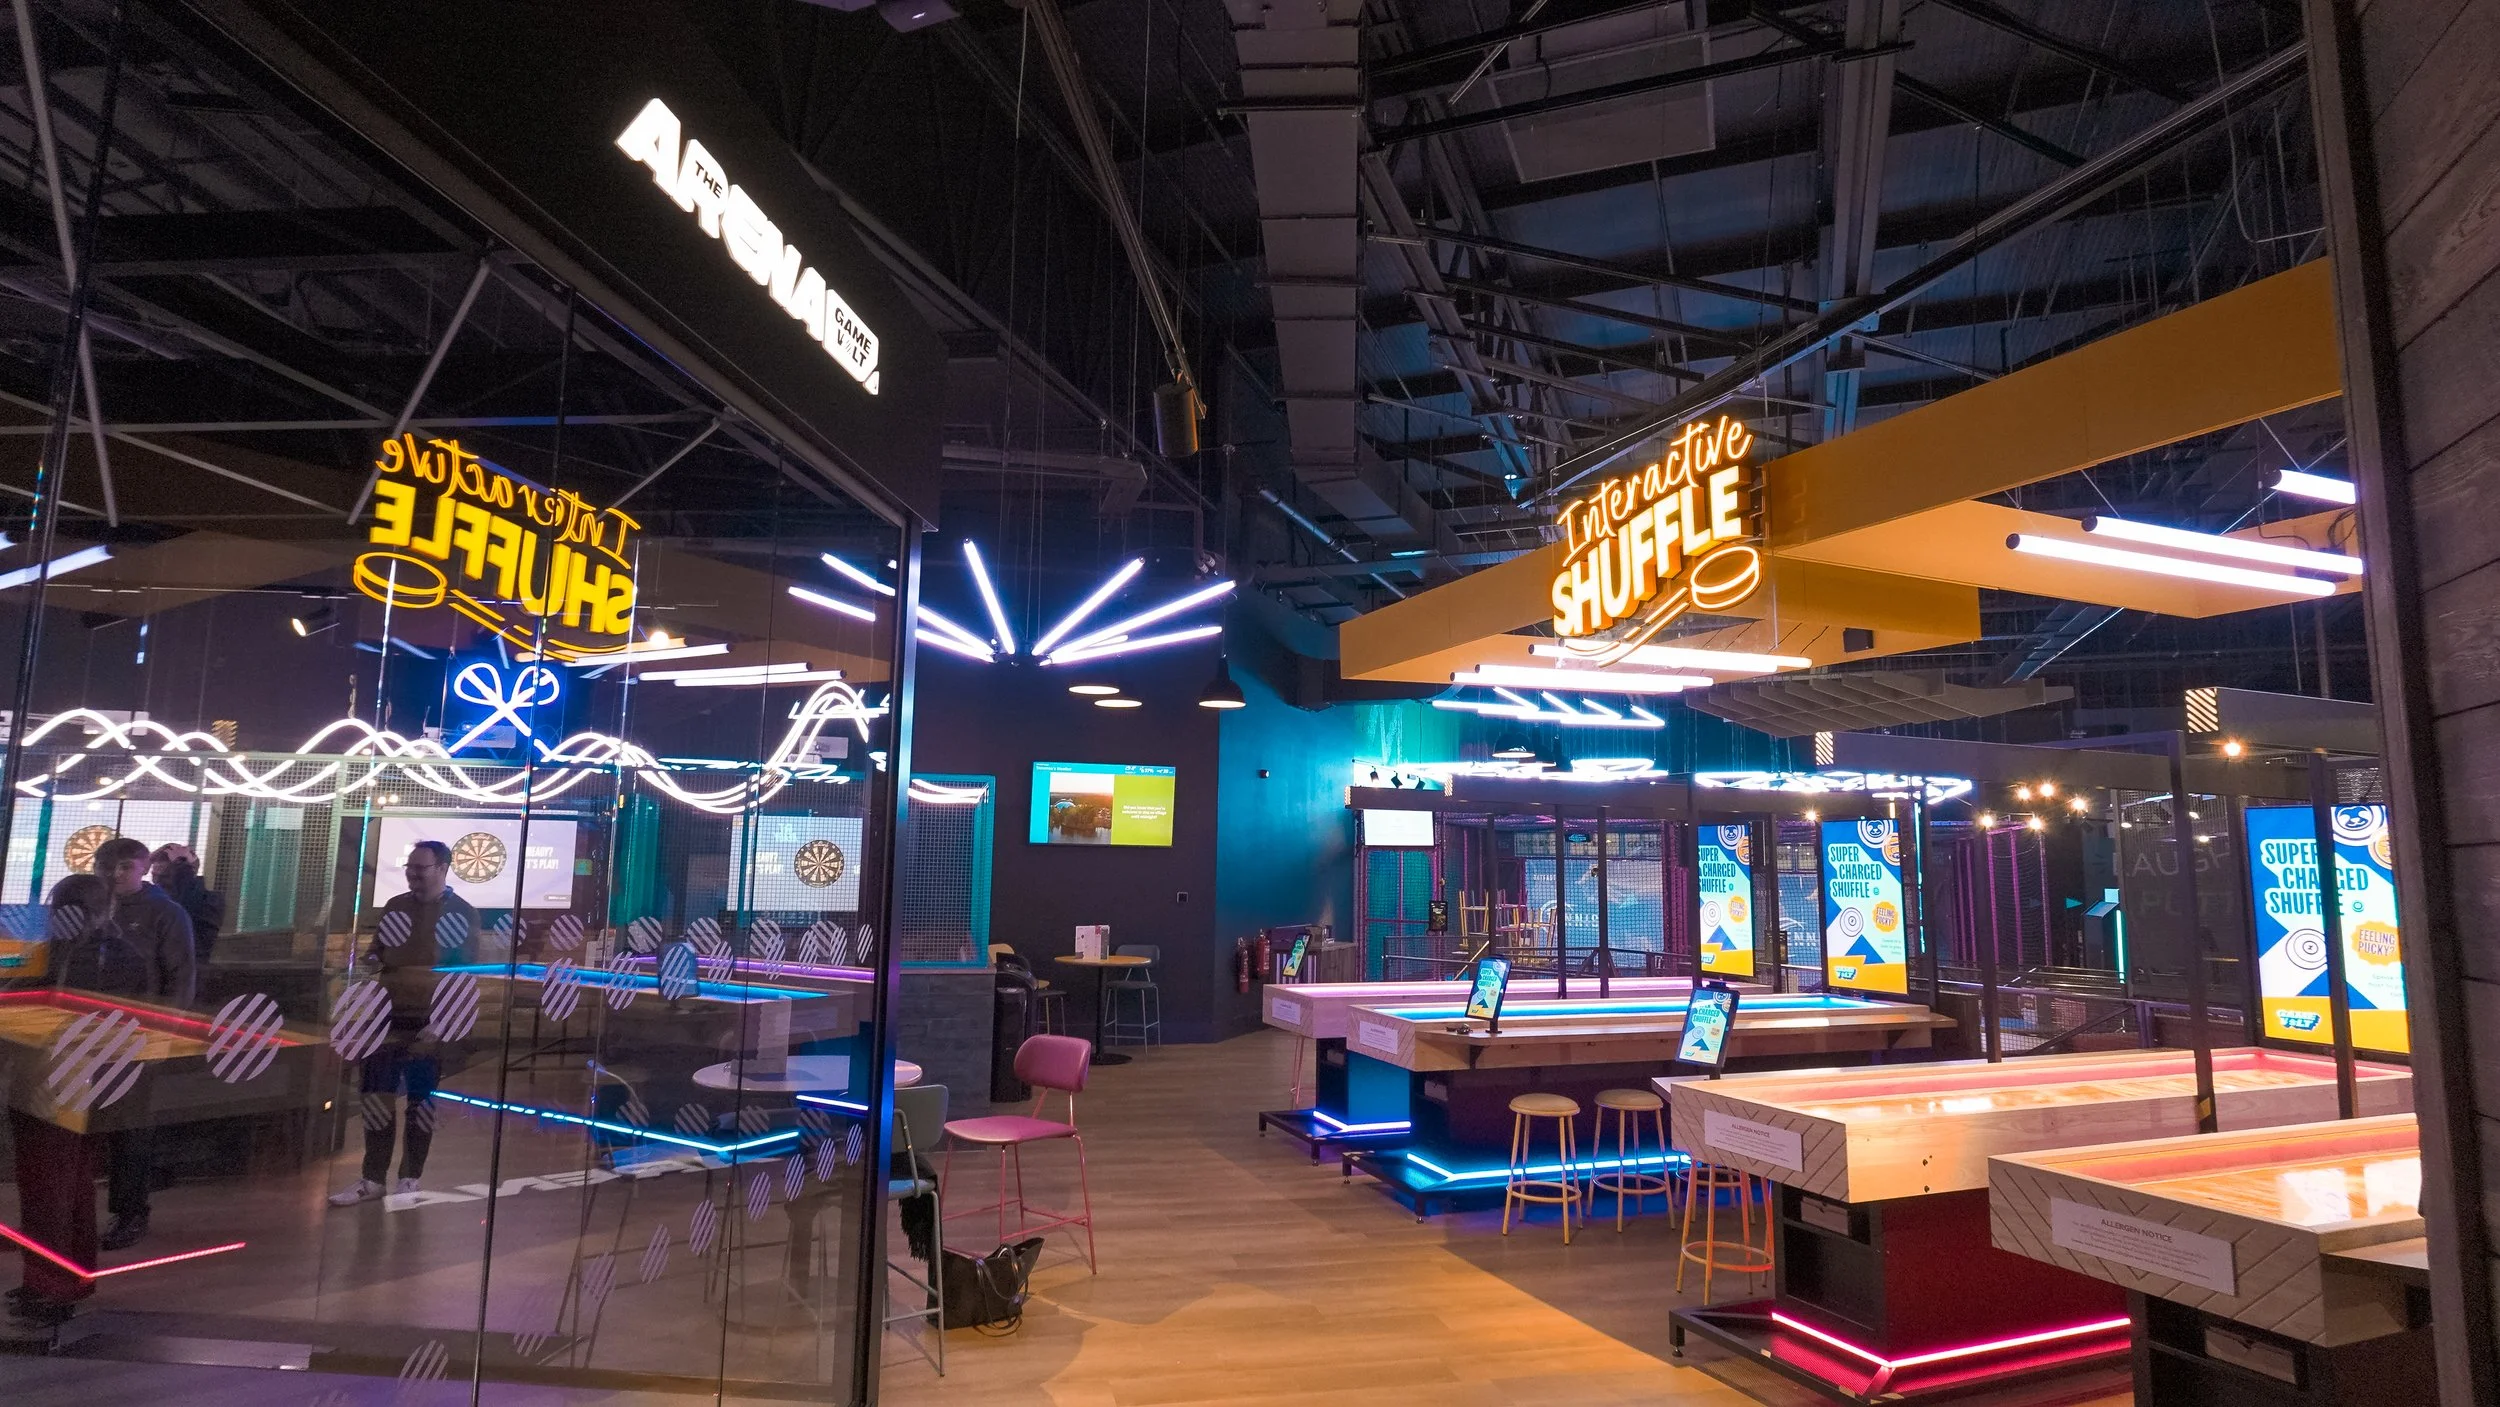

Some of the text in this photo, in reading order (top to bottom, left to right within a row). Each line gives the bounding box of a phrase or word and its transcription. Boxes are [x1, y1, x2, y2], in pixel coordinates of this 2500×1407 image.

[694, 160, 723, 199] THE
[835, 307, 872, 355] GAME
[1557, 415, 1754, 568] Interactive
[1552, 465, 1743, 637] SHUFFLE
[1699, 847, 1719, 861] UPER
[1830, 845, 1860, 862] SUPER
[1702, 863, 1736, 878] CHARGED
[1839, 863, 1882, 880] CHARGED
[2282, 867, 2369, 891] CHAGED
[1832, 881, 1871, 899] SHUFFLE
[1876, 907, 1895, 918] FEELING
[2269, 892, 2345, 916] SHUFFE
[2359, 929, 2396, 945] FEELING
[2358, 941, 2396, 956] PUCKY?
[1693, 1014, 1712, 1024] SHUFFLE
[1698, 1008, 1720, 1018] CHARGED
[2101, 1218, 2173, 1243] ALLERGEN NOTICE
